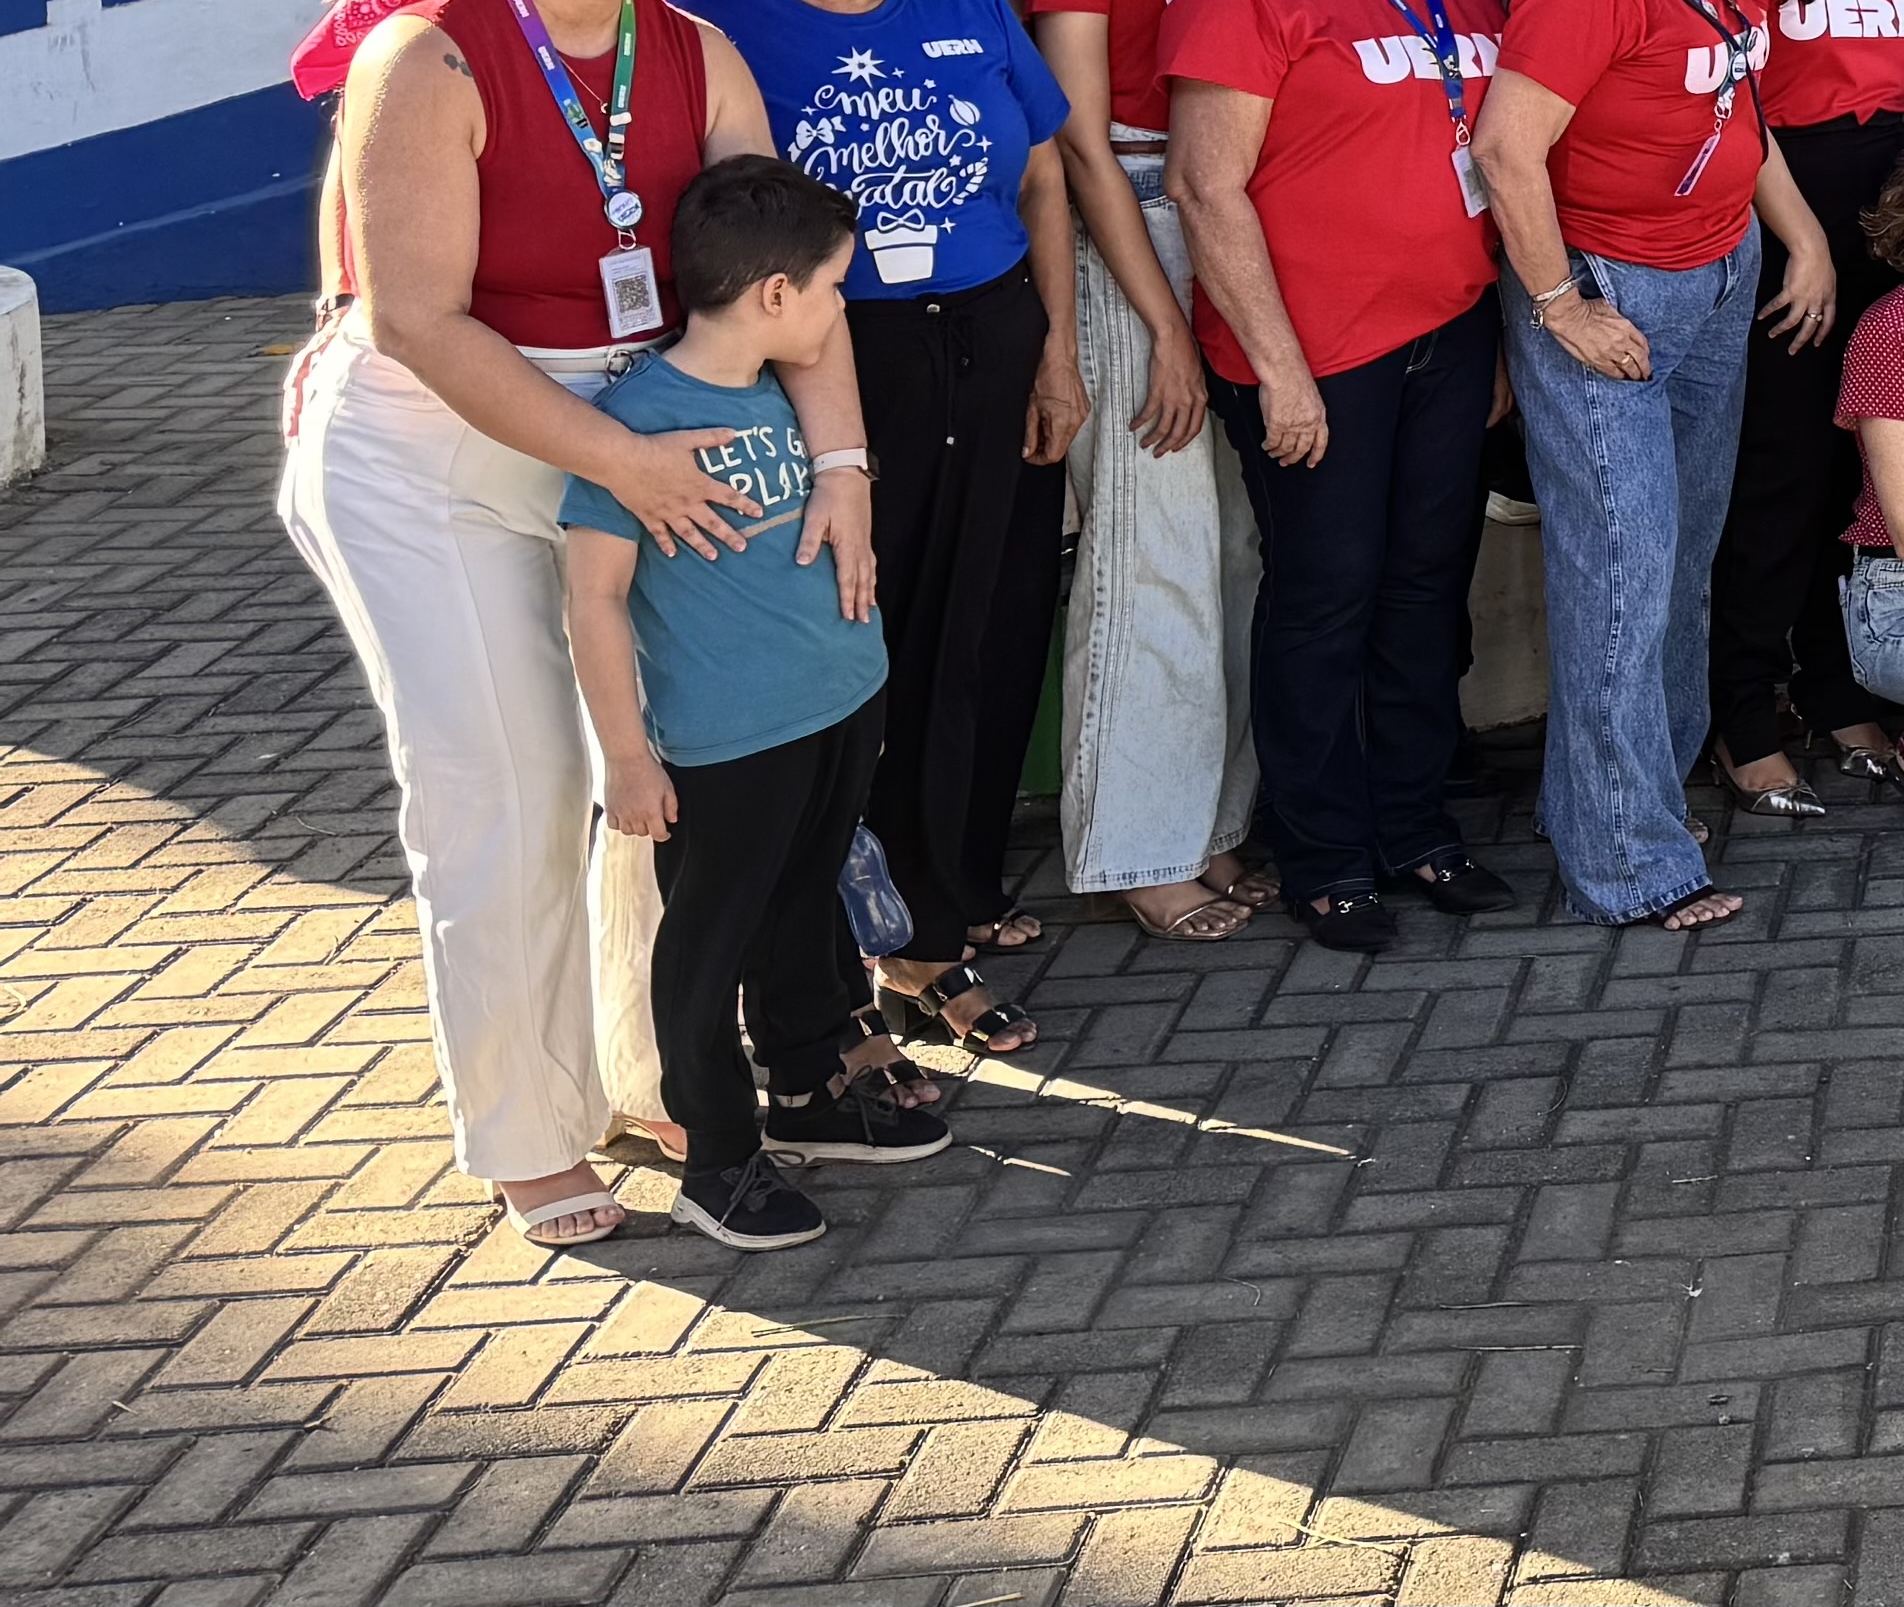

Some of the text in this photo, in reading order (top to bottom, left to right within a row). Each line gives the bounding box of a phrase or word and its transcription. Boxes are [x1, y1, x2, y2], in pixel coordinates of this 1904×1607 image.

[922, 38, 984, 59] UERN
[814, 84, 937, 120] meu
[804, 114, 976, 181] melhor
[822, 165, 957, 220] atal
[699, 426, 777, 474] LET'S
[729, 461, 811, 515] PLAY
